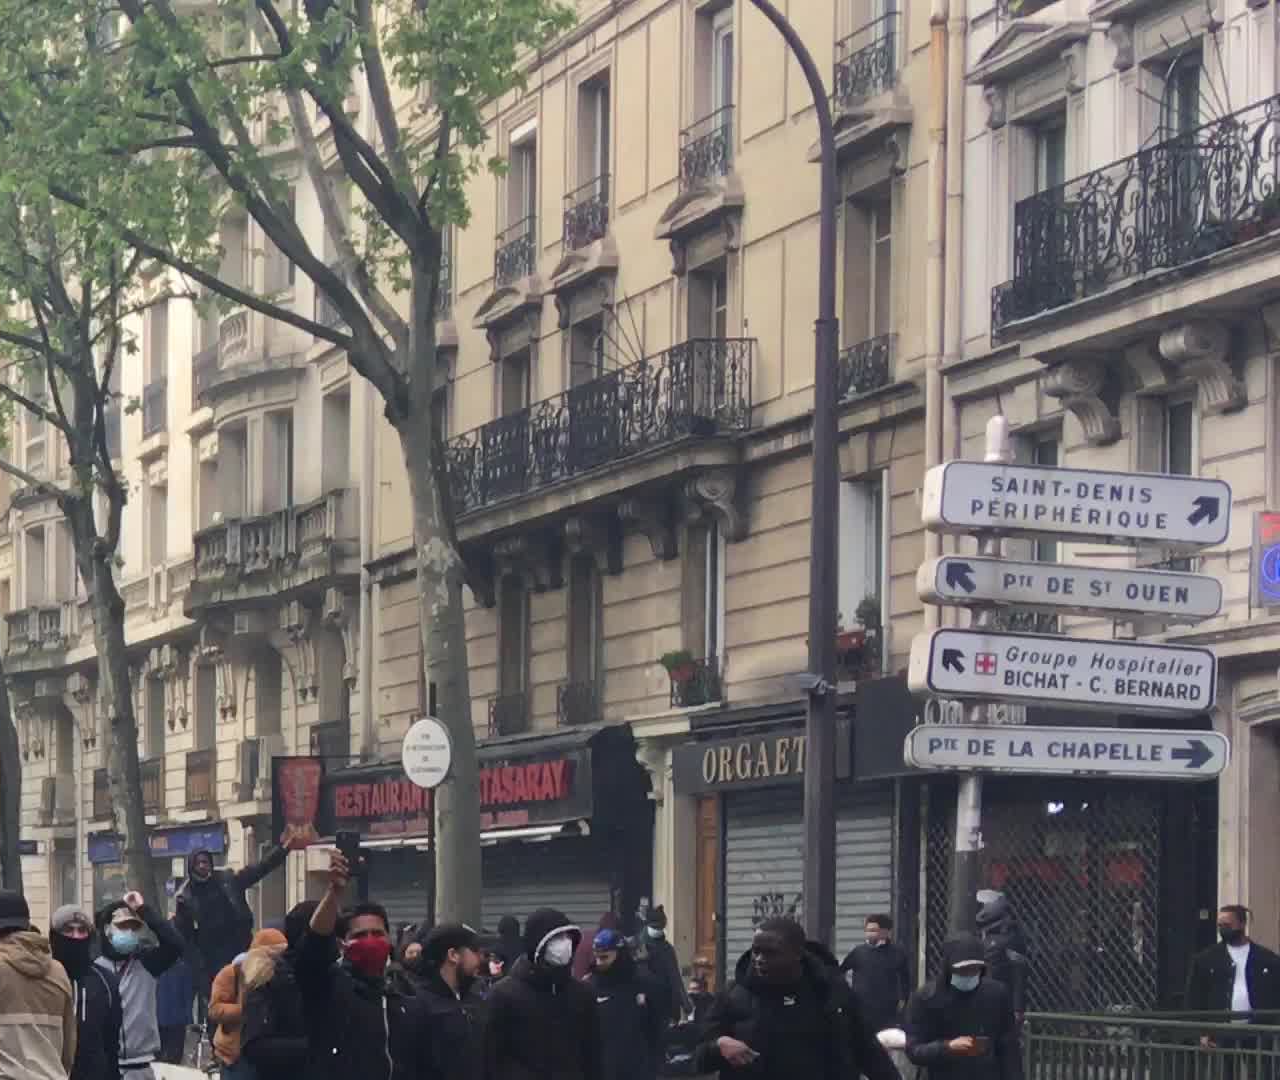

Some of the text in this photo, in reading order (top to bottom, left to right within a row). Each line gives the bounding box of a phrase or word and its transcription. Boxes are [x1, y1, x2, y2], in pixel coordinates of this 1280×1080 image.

[991, 476, 1153, 504] SAINT-DENIS
[971, 498, 1168, 529] PÉRIPHÉRIQUE
[1047, 577, 1074, 595] DE
[1126, 583, 1189, 604] OUEN
[1006, 646, 1203, 677] Groupe Hospitalier
[1004, 670, 1070, 690] BICHAT
[1090, 676, 1107, 694] C.
[1115, 678, 1201, 701] BERNARD
[967, 739, 996, 756] DE
[1008, 741, 1033, 757] LA
[1047, 741, 1162, 761] CHAPELLE
[480, 760, 570, 804] TASARAY
